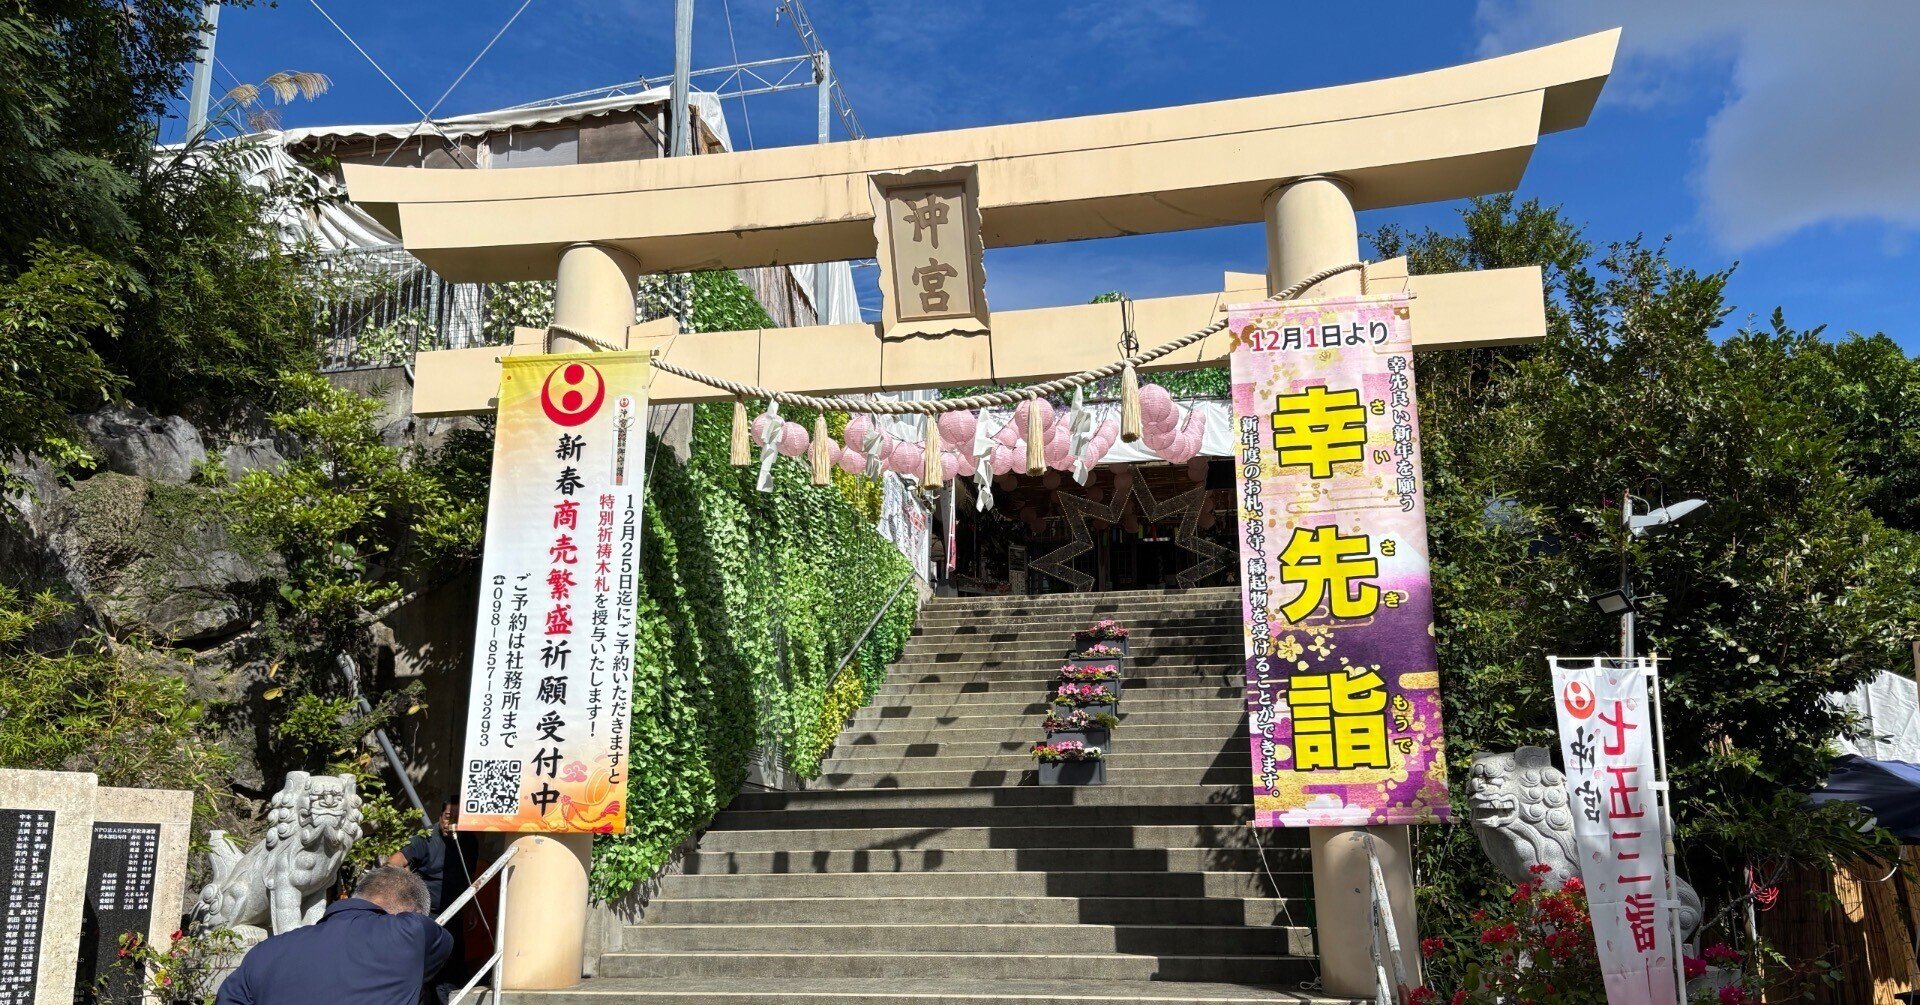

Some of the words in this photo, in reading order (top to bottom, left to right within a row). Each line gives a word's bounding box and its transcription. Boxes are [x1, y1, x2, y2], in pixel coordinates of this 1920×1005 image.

[903, 193, 958, 314] 沖宮
[1251, 321, 1389, 352] 12月1日より
[1387, 356, 1416, 512] 幸先良い新年を願う
[500, 573, 531, 749] ご予約は社務所まで
[530, 432, 588, 817] 新春商売繁盛祈願受付中
[608, 494, 636, 785] 12月25日迄にご予約いただきますと
[1271, 385, 1390, 772] 幸先詣
[1393, 694, 1412, 755] もうで
